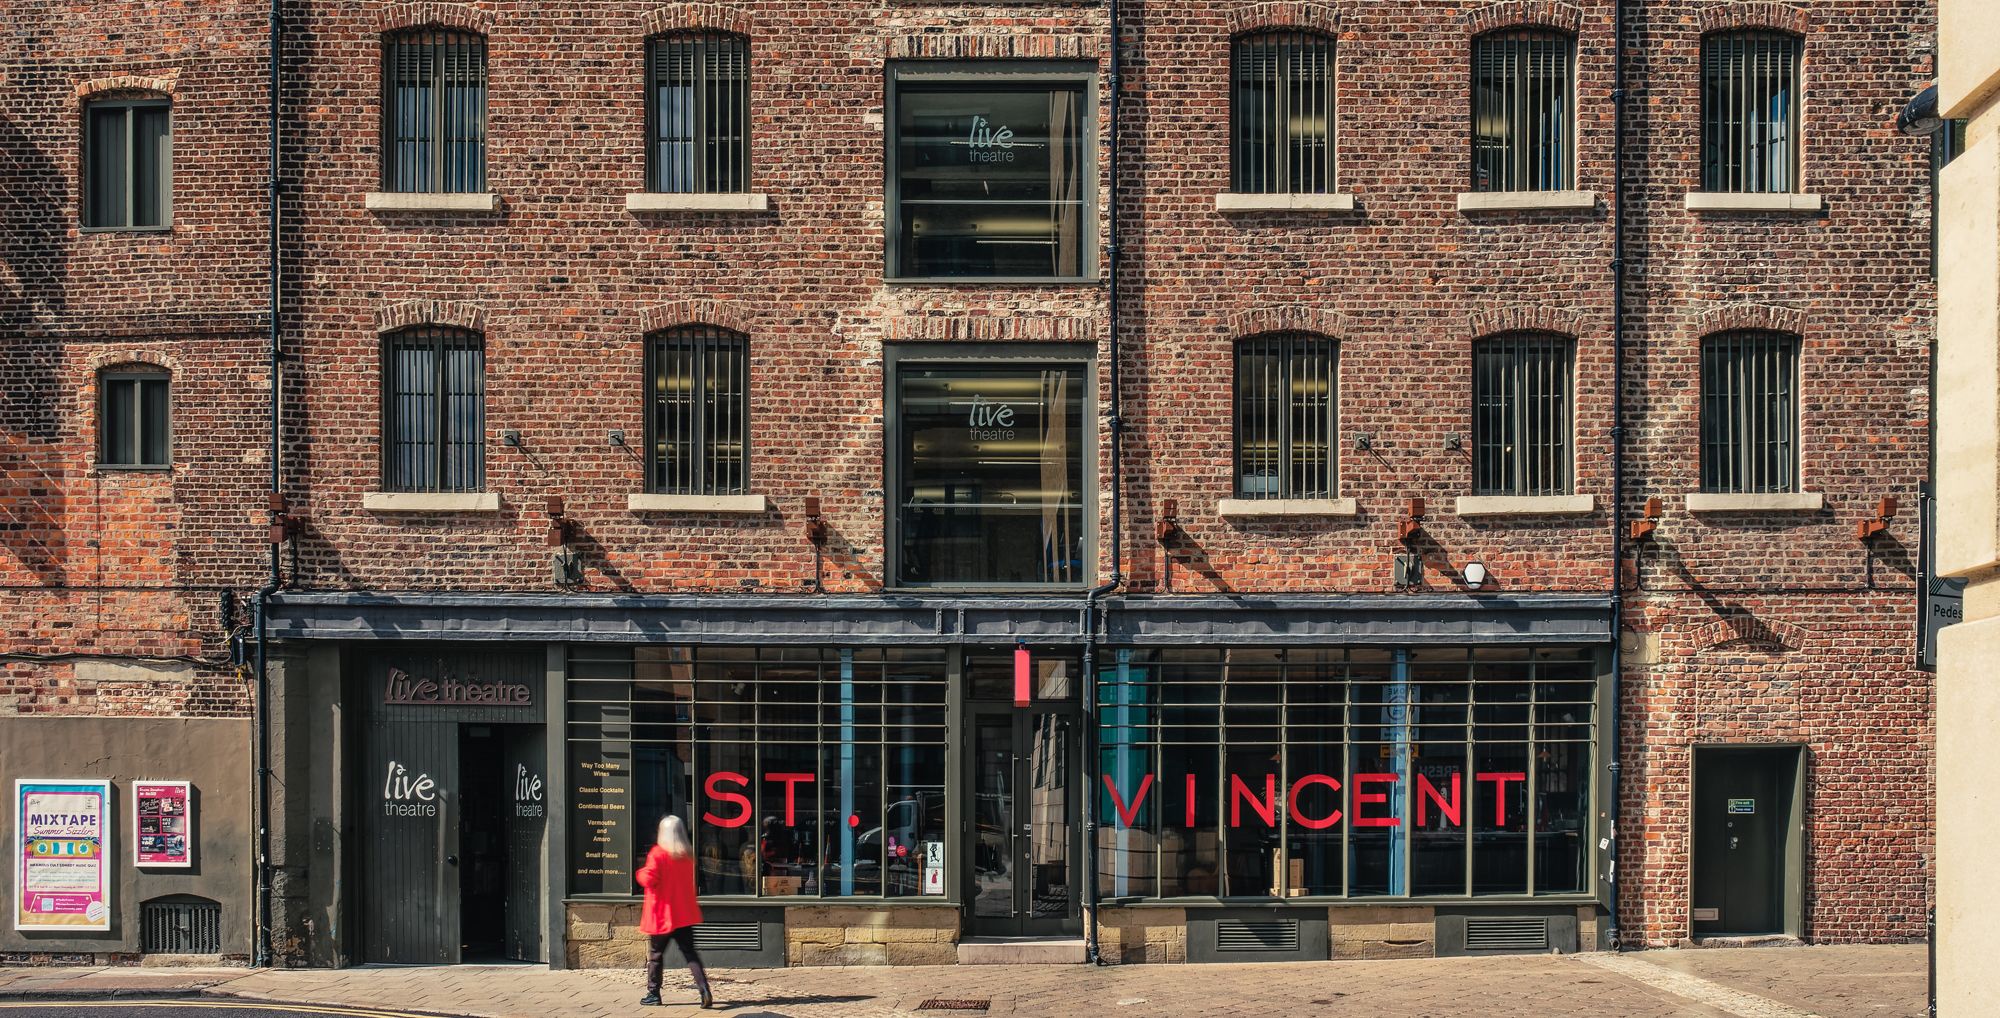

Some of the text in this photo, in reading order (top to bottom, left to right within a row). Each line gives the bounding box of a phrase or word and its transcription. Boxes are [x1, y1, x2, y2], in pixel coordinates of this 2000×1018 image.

[969, 115, 1014, 148] live
[969, 149, 1014, 162] theatre
[969, 394, 1015, 427] live
[970, 428, 1015, 441] theatre
[384, 667, 531, 702] live theatre
[384, 761, 436, 800] live
[515, 762, 542, 800] live
[385, 801, 436, 817] theatre
[516, 803, 543, 817] theatre
[1103, 773, 1526, 829] VINCENT
[30, 814, 96, 826] MIXTAPE
[33, 826, 95, 836] Summer Sizzlers
